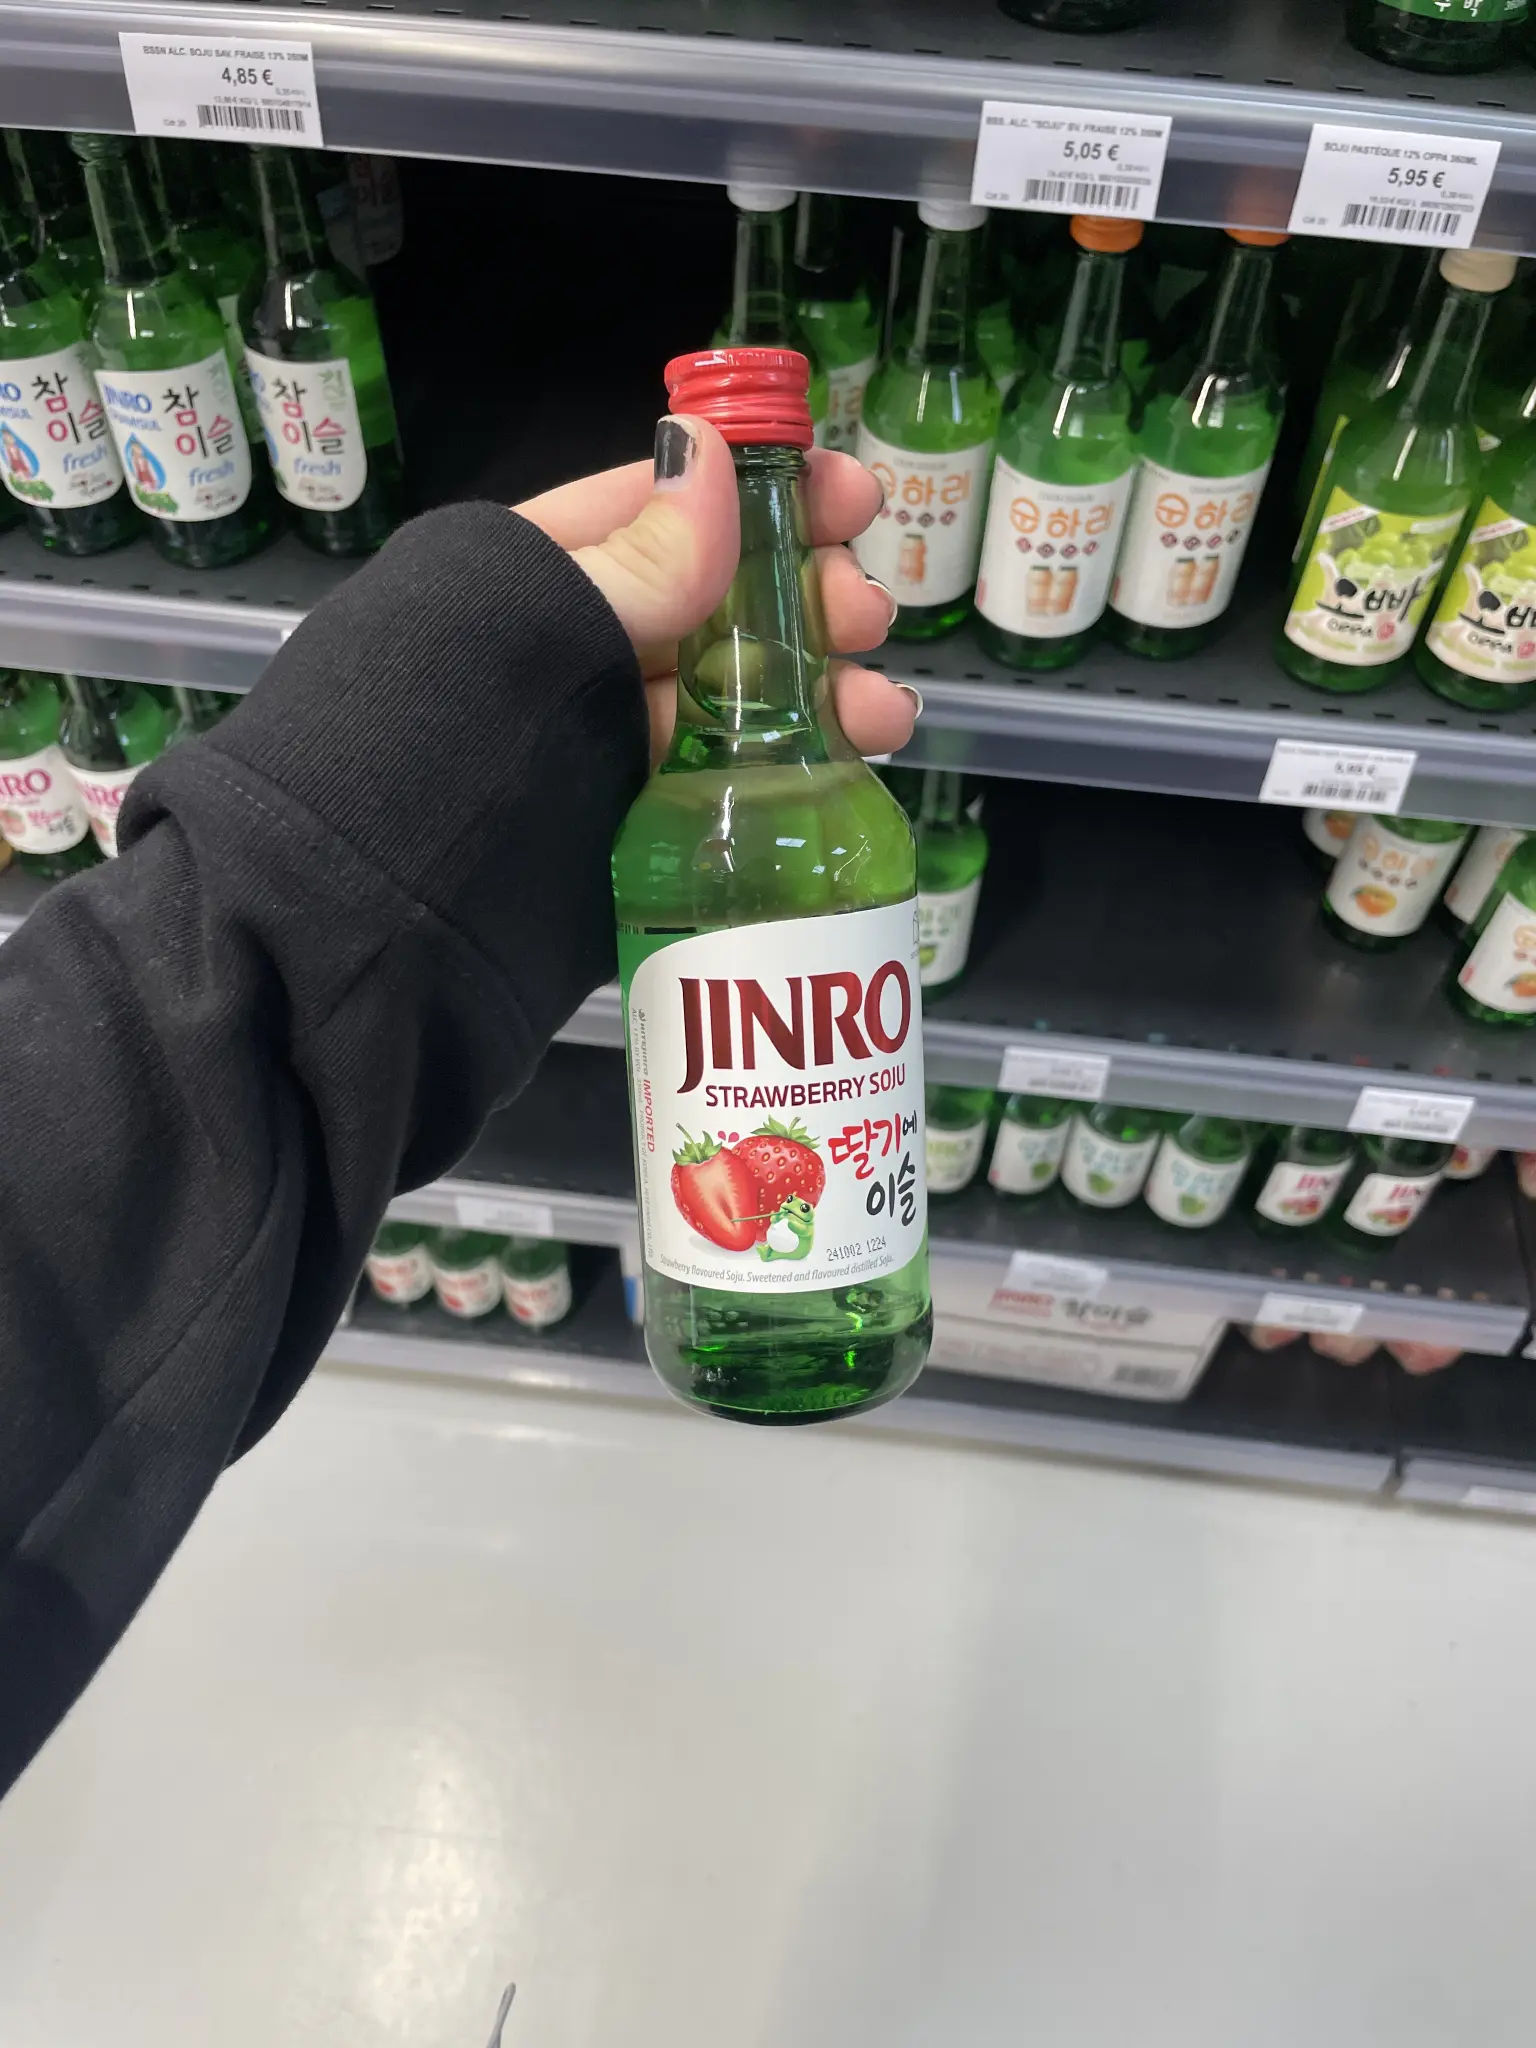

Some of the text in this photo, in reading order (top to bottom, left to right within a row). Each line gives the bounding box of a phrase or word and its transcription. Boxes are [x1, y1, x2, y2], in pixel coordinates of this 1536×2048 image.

[189, 48, 213, 57] SOJU
[234, 50, 265, 60] FRAISE
[221, 67, 274, 86] 4,85 €
[1083, 123, 1117, 135] FRAISE
[1063, 140, 1120, 162] 5,05 €
[1324, 142, 1349, 153] SOJU
[1402, 149, 1421, 161] 12%
[1423, 152, 1447, 163] OPPA
[1386, 167, 1446, 189] 5,95 €
[62, 446, 108, 475] fresh
[188, 459, 236, 488] fresh
[293, 458, 342, 477] fresh
[676, 959, 912, 1095] JINRO
[705, 1063, 906, 1109] STRAWBERRY SOJU
[643, 1078, 656, 1153] IMPORTED
[828, 1110, 918, 1180] 딸기에
[866, 1151, 918, 1227] 이슬
[826, 1235, 888, 1262] 241002 1224
[660, 1253, 895, 1283] Strawberry flavoured Soju. Sweetened and flavoured distilled Soju.
